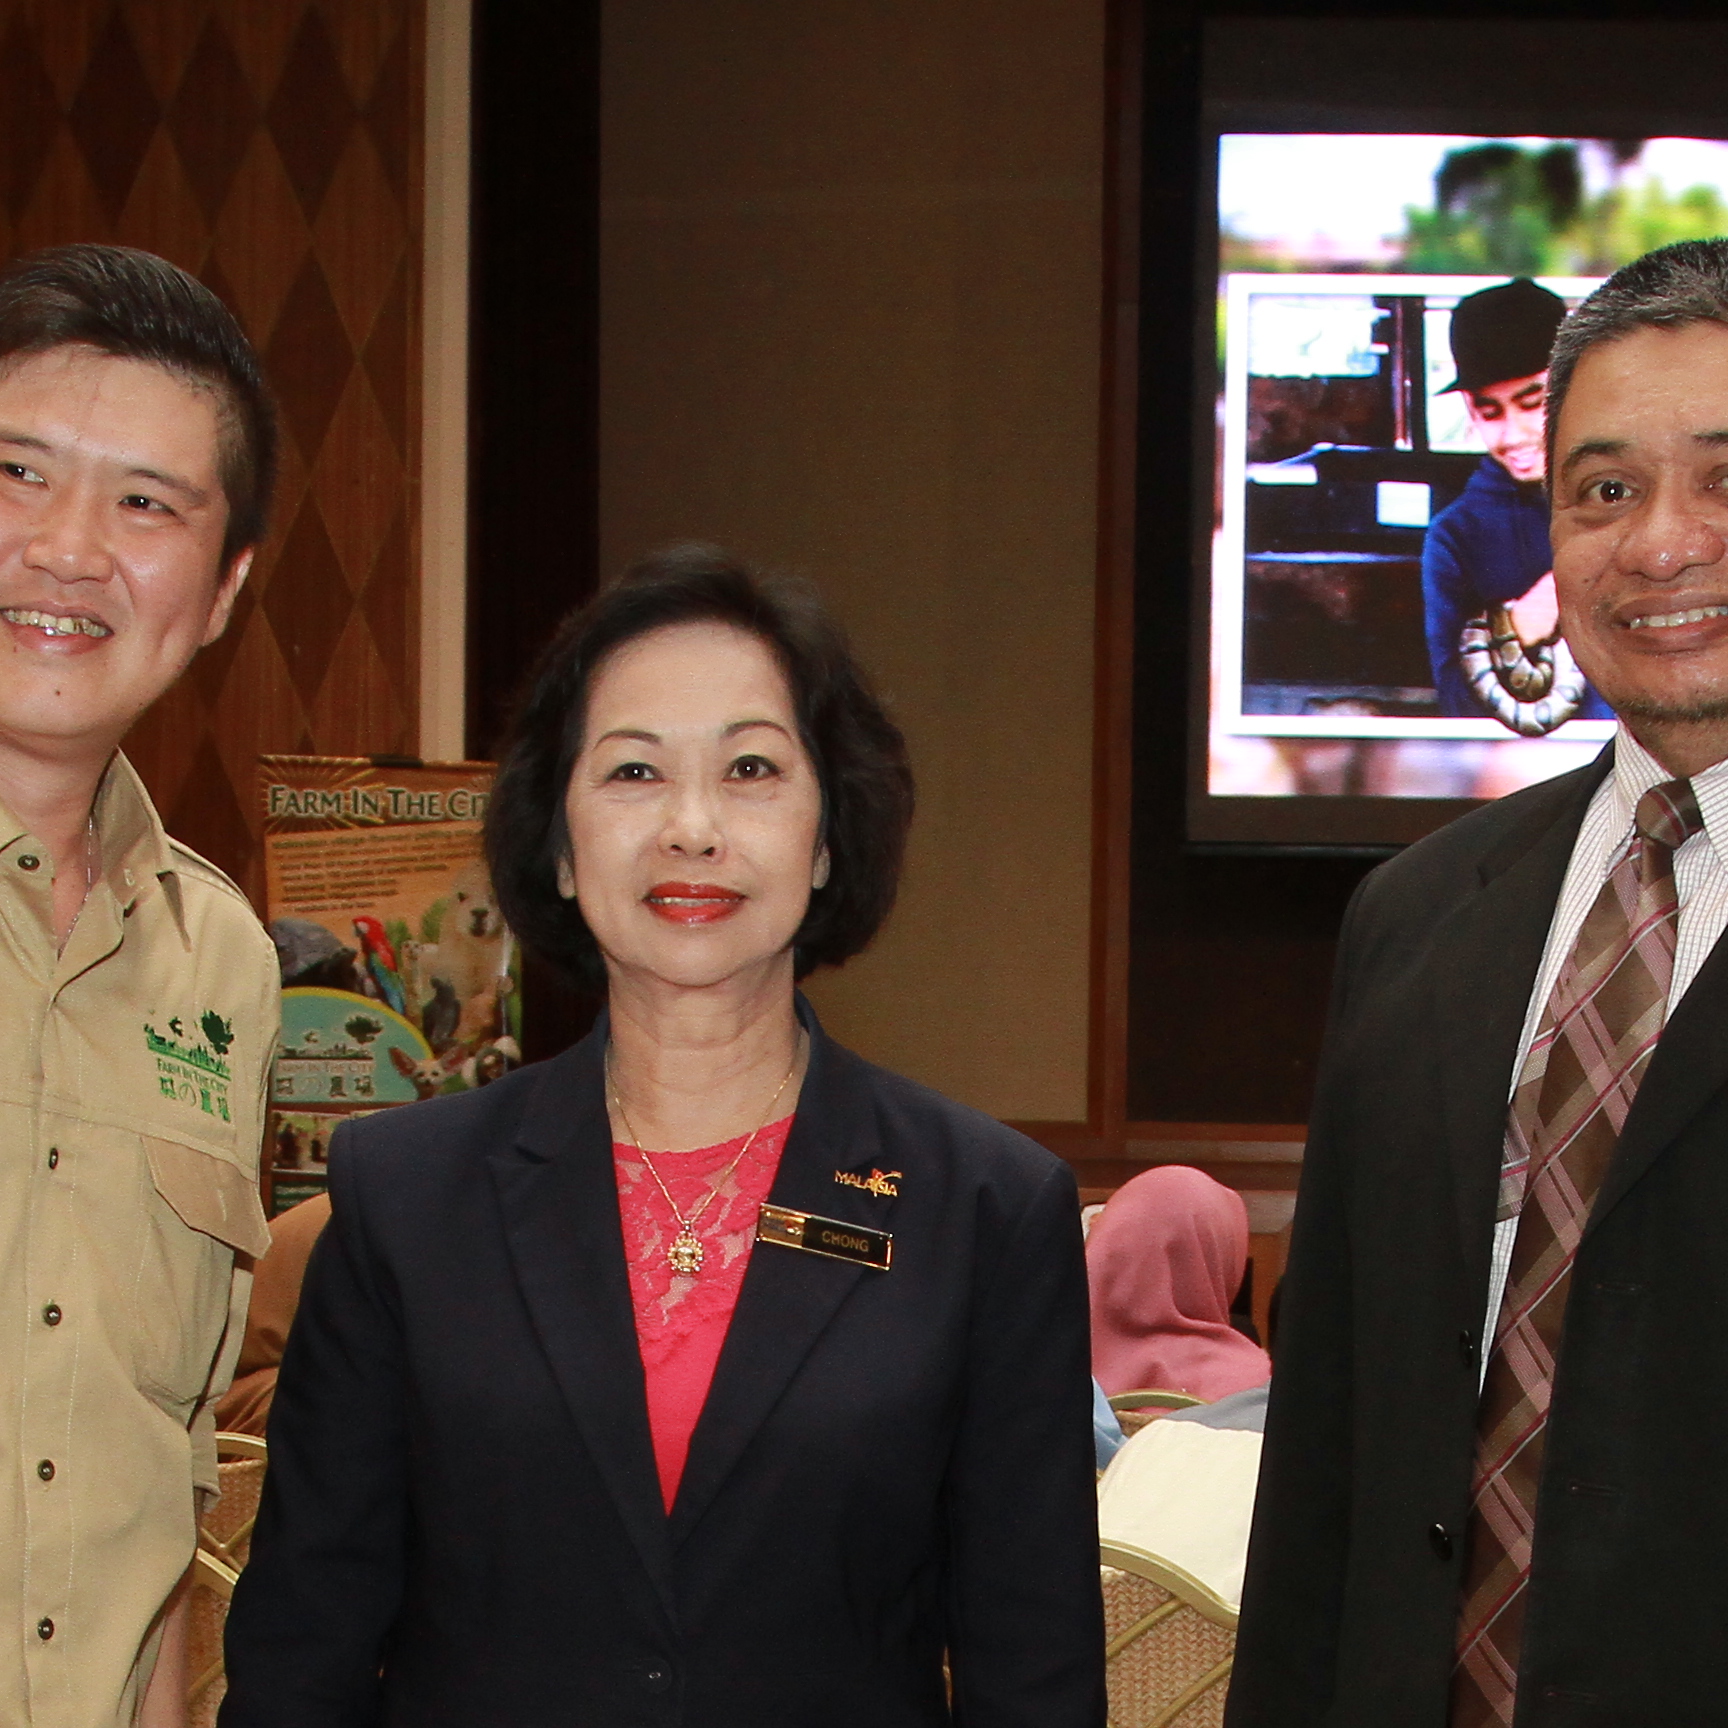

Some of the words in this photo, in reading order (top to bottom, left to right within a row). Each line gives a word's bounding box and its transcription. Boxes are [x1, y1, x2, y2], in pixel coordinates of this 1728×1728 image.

[270, 785, 342, 815] FARM
[351, 787, 378, 815] IN
[386, 788, 441, 816] THE
[834, 1169, 899, 1197] MALAYSIA
[822, 1230, 869, 1252] CHONG
